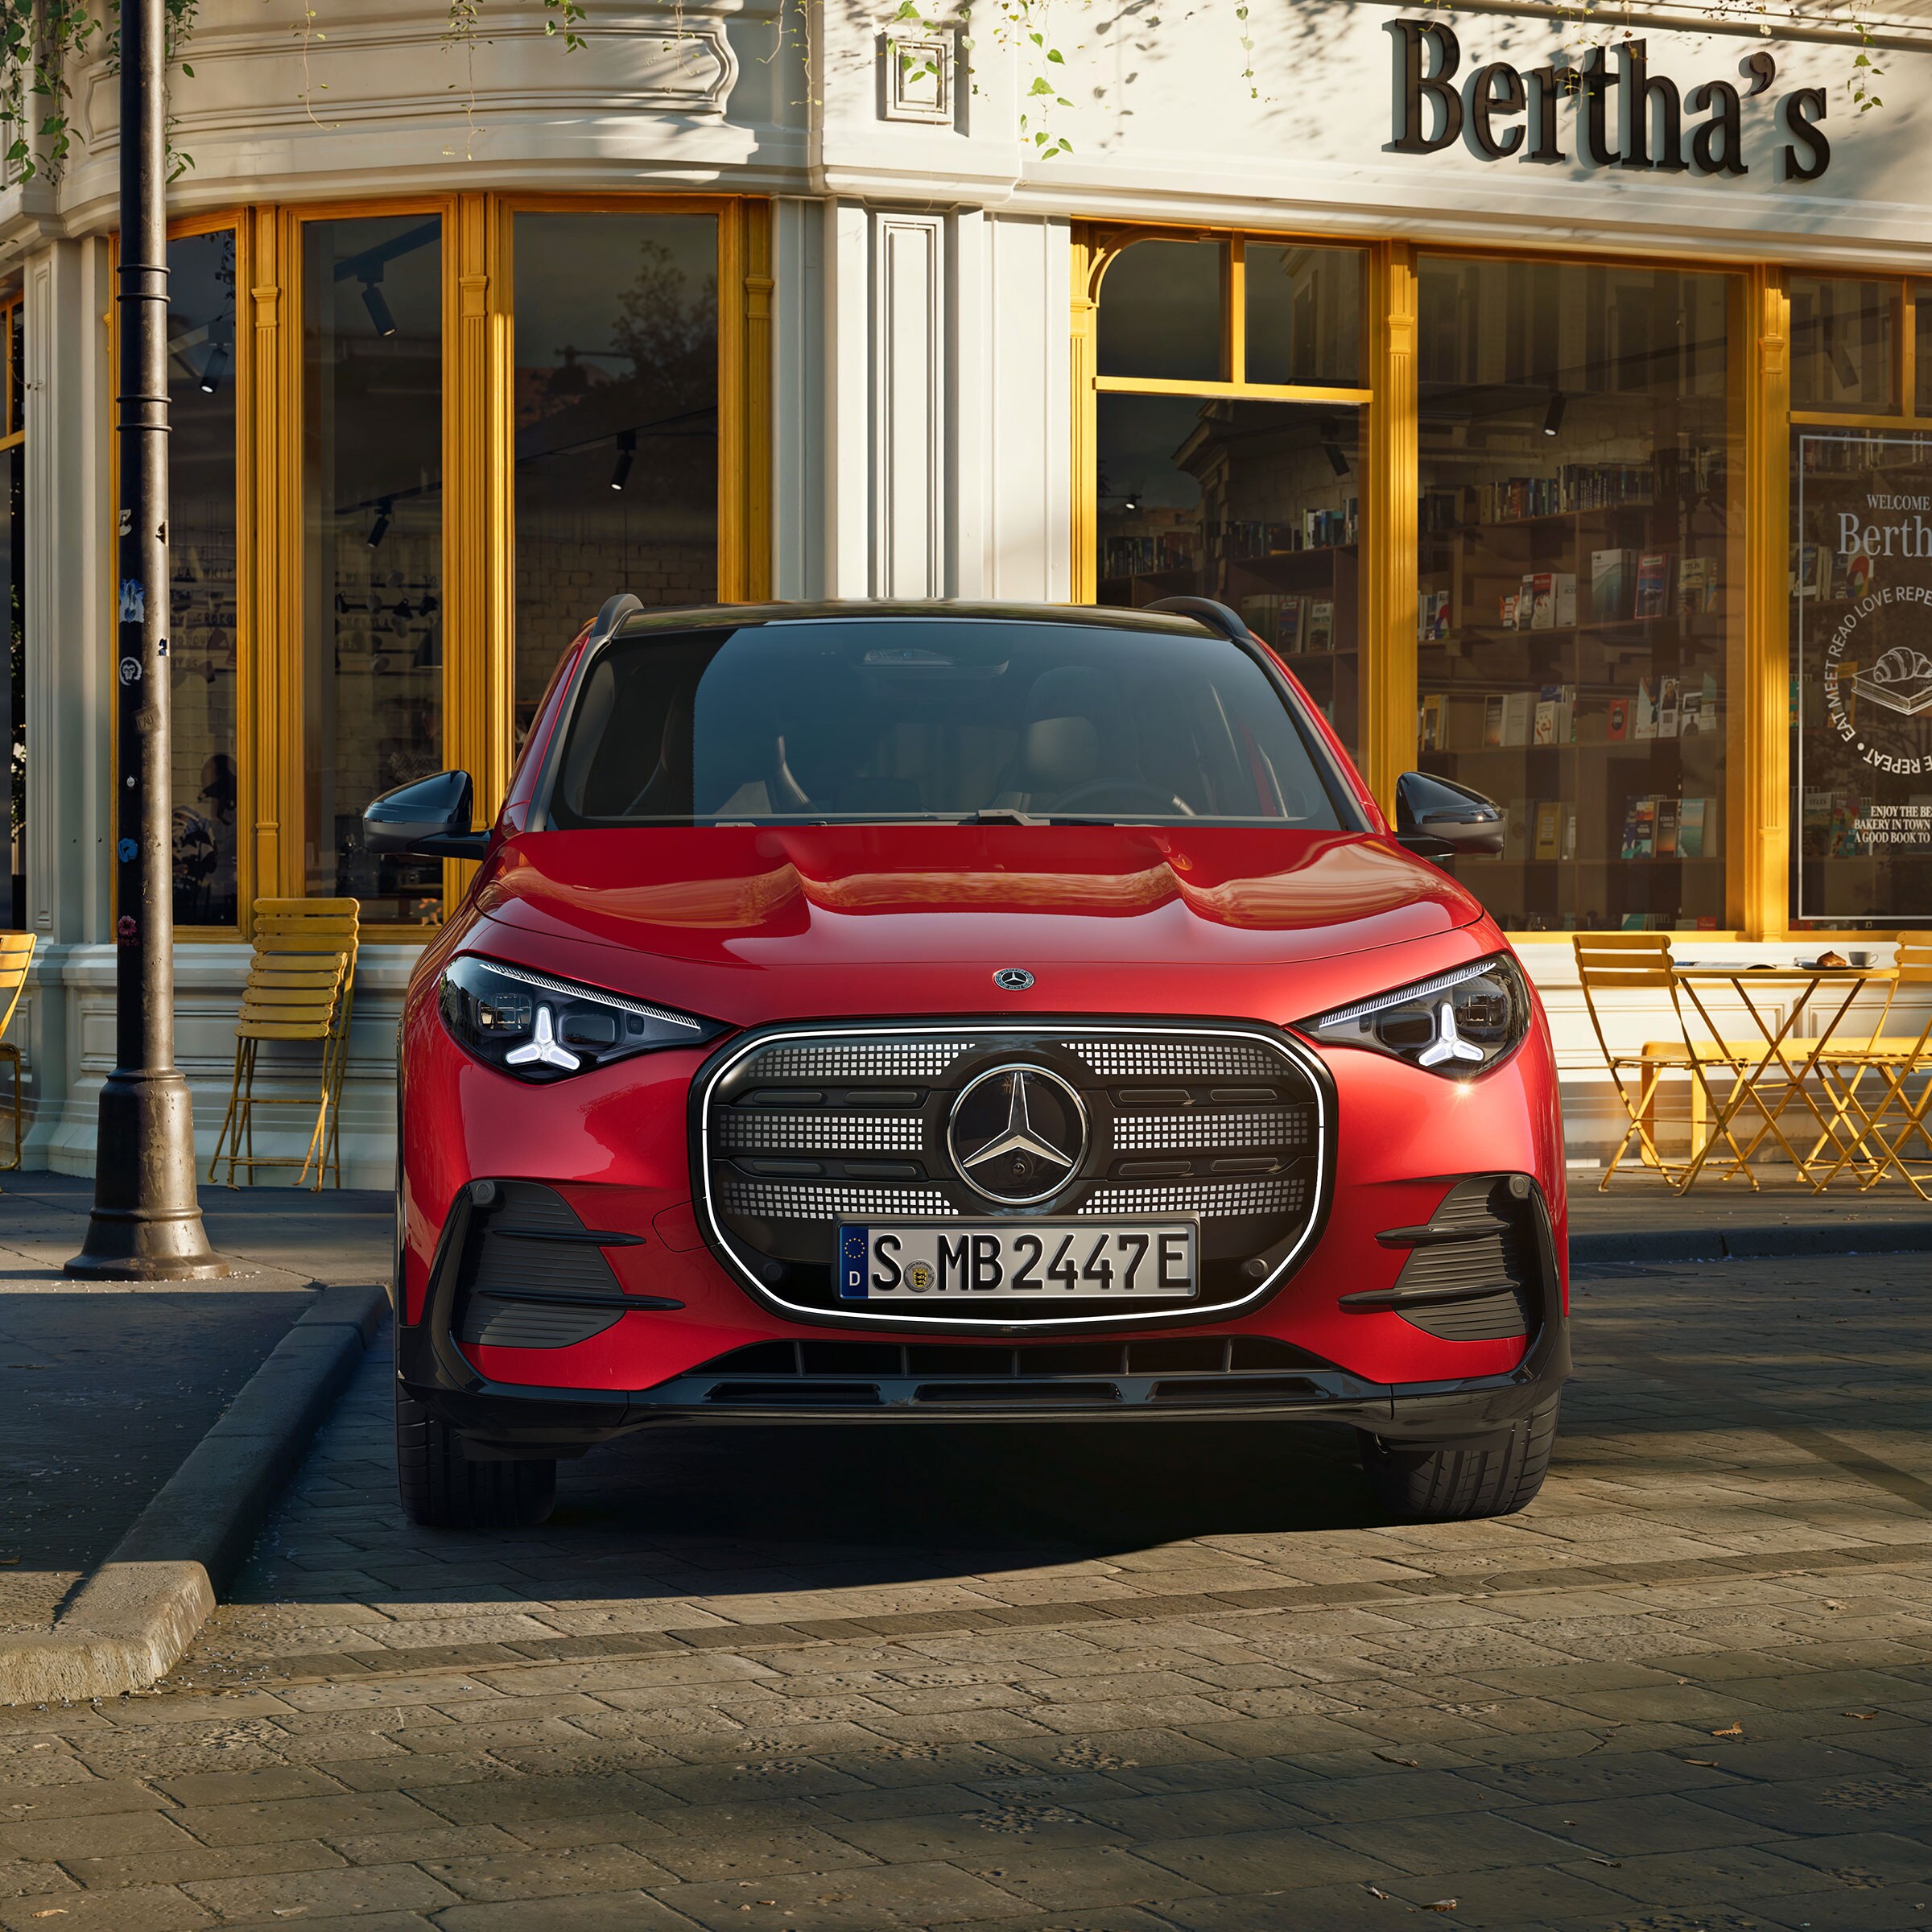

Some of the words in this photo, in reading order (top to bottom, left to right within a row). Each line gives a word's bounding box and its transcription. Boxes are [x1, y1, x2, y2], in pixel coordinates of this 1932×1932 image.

[1867, 493, 1931, 511] WELCOME
[1836, 512, 1932, 558] Berth
[1854, 587, 1893, 619] LOVE
[1824, 659, 1843, 708] MEET
[1831, 712, 1856, 742] EAT
[1862, 748, 1922, 774] REPEAT
[1854, 819, 1891, 830] BAKERY
[1892, 819, 1902, 830] IN
[1902, 819, 1931, 831] TOWN
[1870, 805, 1899, 819] ENJOY
[1899, 806, 1918, 818] THE
[1854, 832, 1861, 843] A
[1862, 832, 1889, 844] GOOD
[1890, 832, 1917, 844] BOOK
[1917, 832, 1930, 844] TO
[872, 1233, 902, 1291] S
[848, 1270, 861, 1286] D
